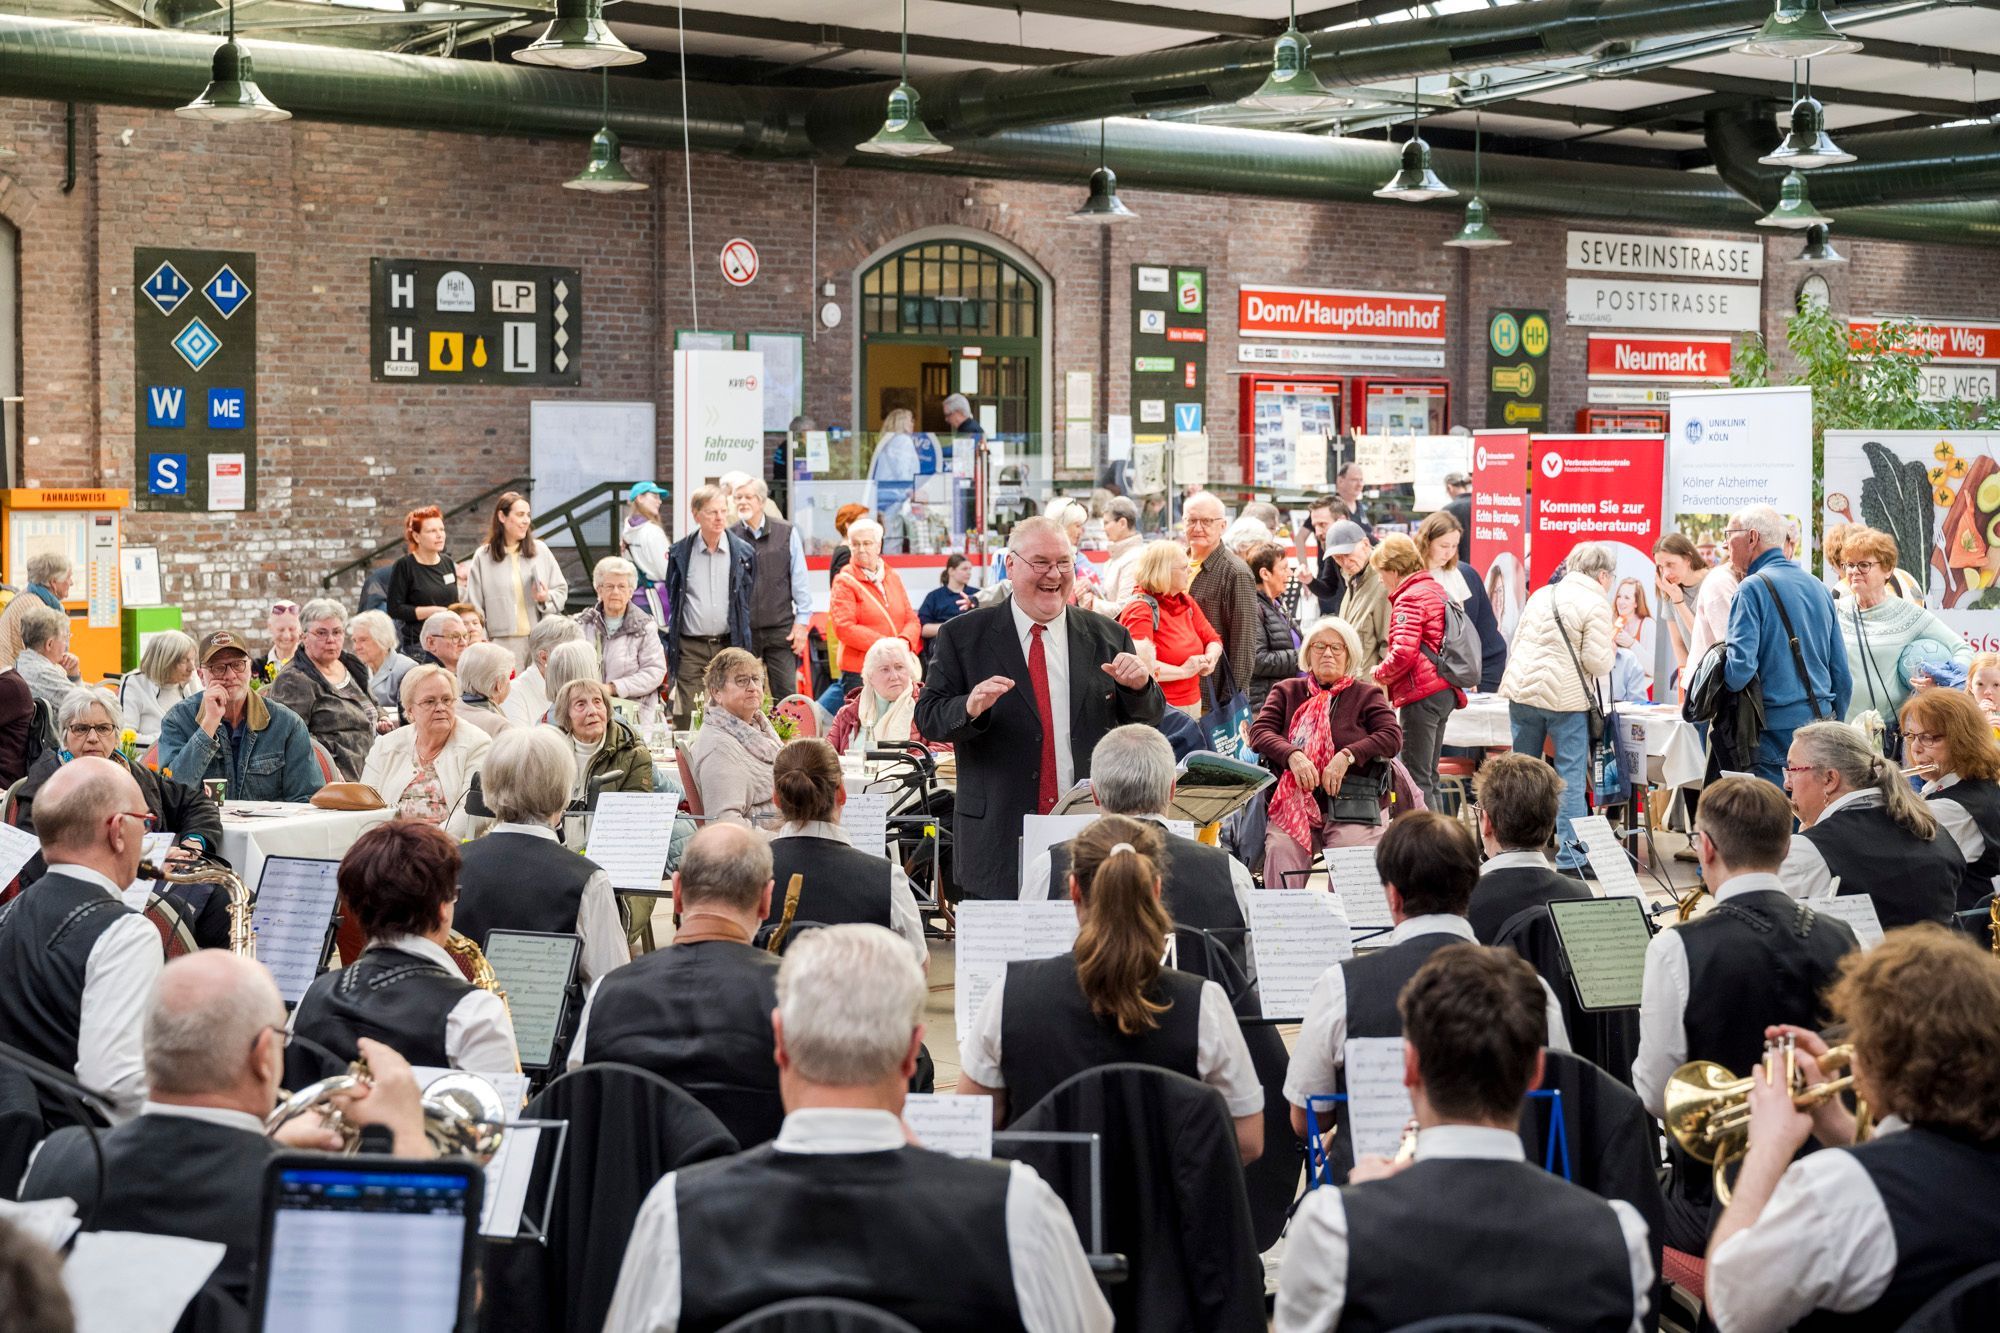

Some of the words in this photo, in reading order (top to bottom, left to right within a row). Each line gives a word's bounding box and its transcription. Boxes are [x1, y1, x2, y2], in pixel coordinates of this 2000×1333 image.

[1580, 240, 1750, 273] SEVERINSTRASSE
[391, 273, 414, 308] H
[447, 279, 465, 292] Halt
[498, 285, 531, 309] LP
[1596, 289, 1728, 314] POSTSTRASSE
[1247, 296, 1441, 331] Dom/Hauptbahnhof
[390, 326, 413, 361] H
[1499, 324, 1511, 345] H
[1526, 326, 1544, 345] HH
[1949, 328, 1986, 357] Weg
[513, 325, 529, 368] L
[1615, 343, 1707, 372] Neumarkt
[386, 363, 418, 374] Kurzzug
[728, 378, 745, 388] KVB
[1954, 375, 1990, 398] WEG
[151, 388, 183, 420] W
[213, 398, 241, 418] ME
[1708, 418, 1747, 427] UNIKLINIK
[704, 436, 759, 452] Fahrzeug-
[1708, 432, 1729, 442] KÖLN
[704, 451, 727, 462] Info
[1564, 458, 1631, 467] Verbraucherzentrale
[156, 457, 179, 491] S
[1682, 476, 1715, 488] Kölner
[1717, 476, 1769, 488] Alzheimer
[41, 492, 107, 502] FAHRAUSWEISE
[1475, 492, 1493, 506] Echte
[1539, 499, 1596, 514] Kommen
[1599, 499, 1619, 514] Sie
[1621, 502, 1645, 514] zur
[1475, 509, 1493, 523] Echte
[1475, 526, 1493, 540] Echte
[1539, 517, 1651, 535] Energieberatung!
